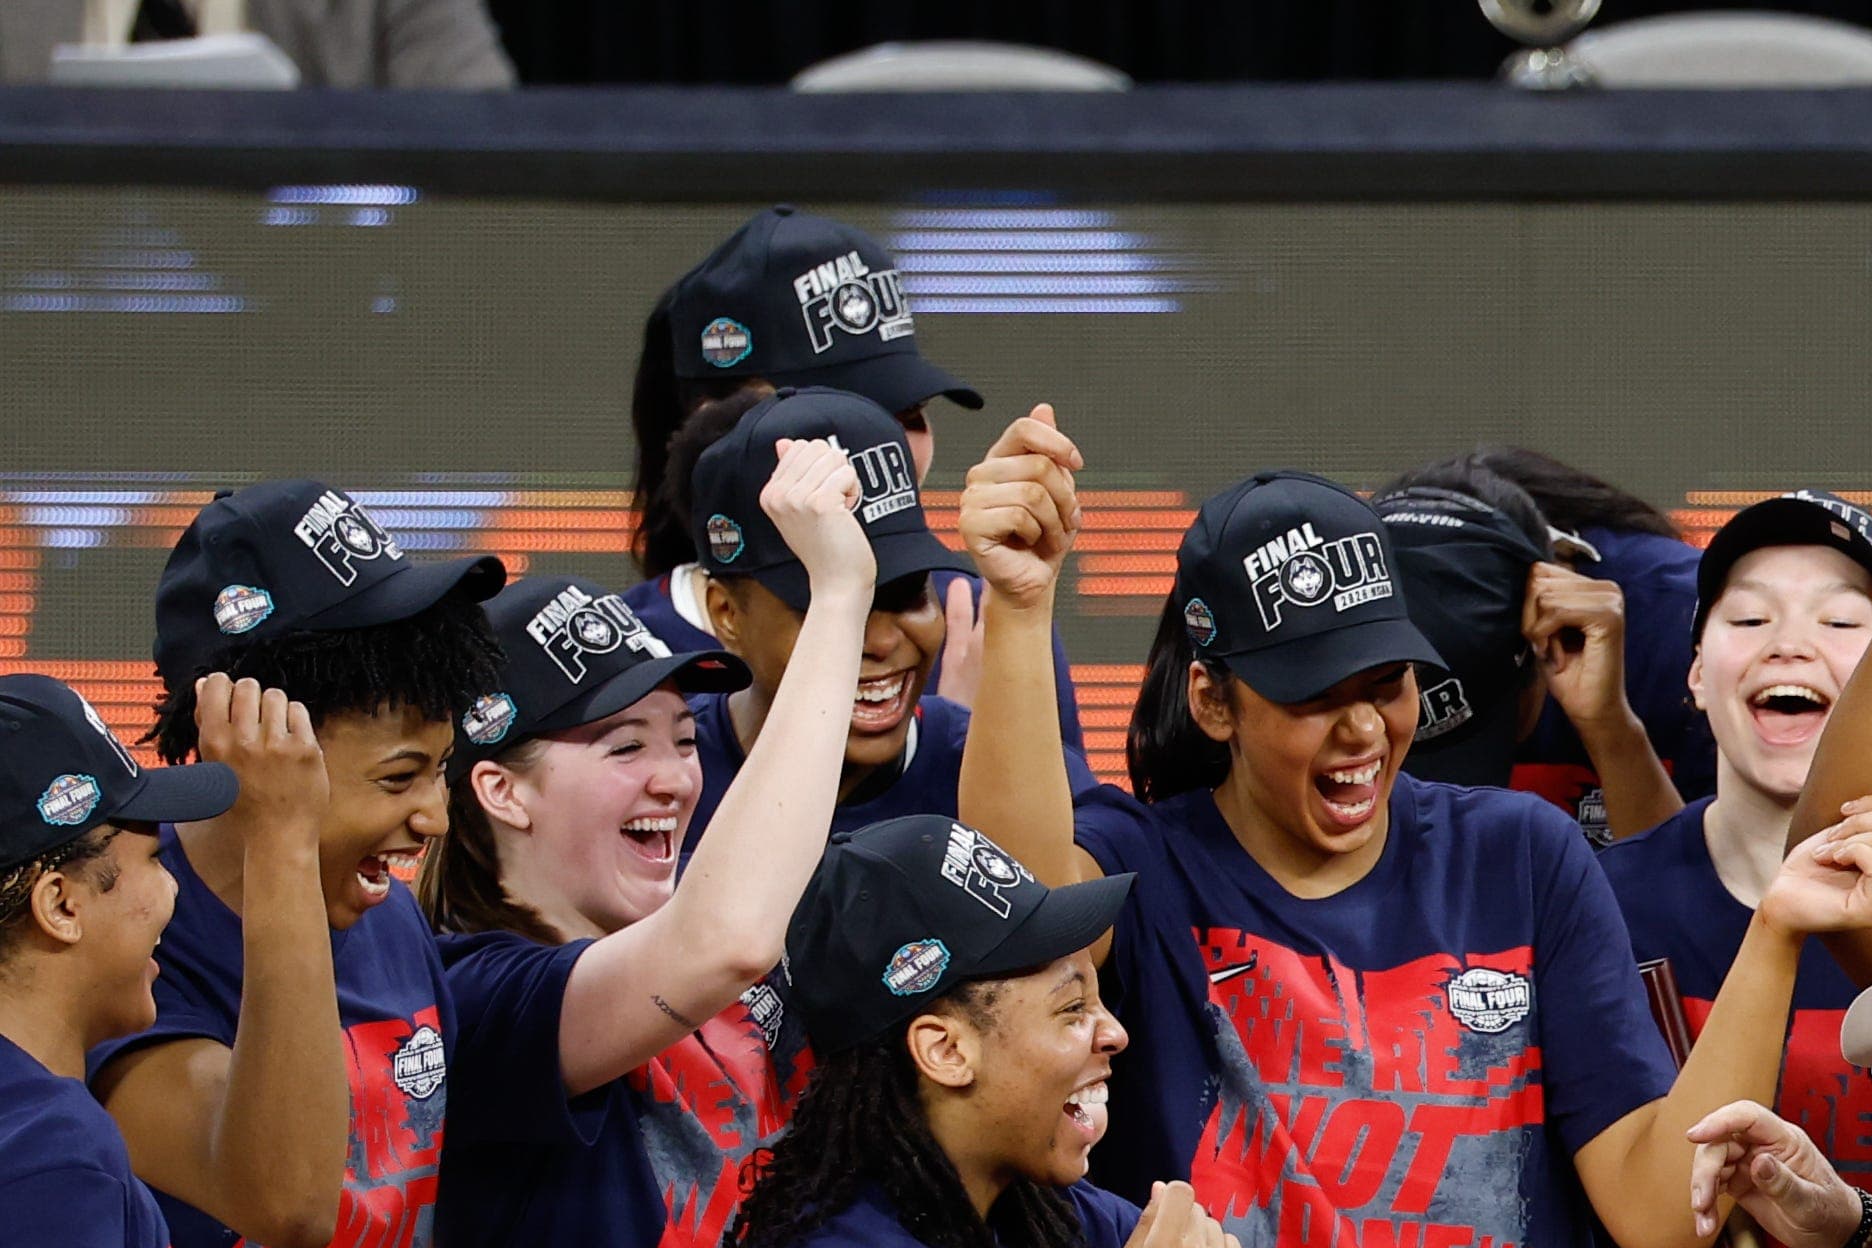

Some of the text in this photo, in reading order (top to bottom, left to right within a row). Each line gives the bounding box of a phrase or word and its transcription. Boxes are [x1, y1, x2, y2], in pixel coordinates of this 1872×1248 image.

[793, 250, 870, 304] FINAL
[849, 441, 913, 503] UR
[293, 489, 349, 548] FINAL
[1242, 521, 1324, 582] FINAL
[1251, 531, 1390, 633] FOUR
[526, 584, 593, 646] FINAL
[940, 823, 977, 887] FINAL
[888, 945, 943, 989] FINAL FOUR
[752, 993, 778, 1024] OUR
[1452, 986, 1526, 1011] FINAL FOUR
[398, 1053, 423, 1078] FINAL
